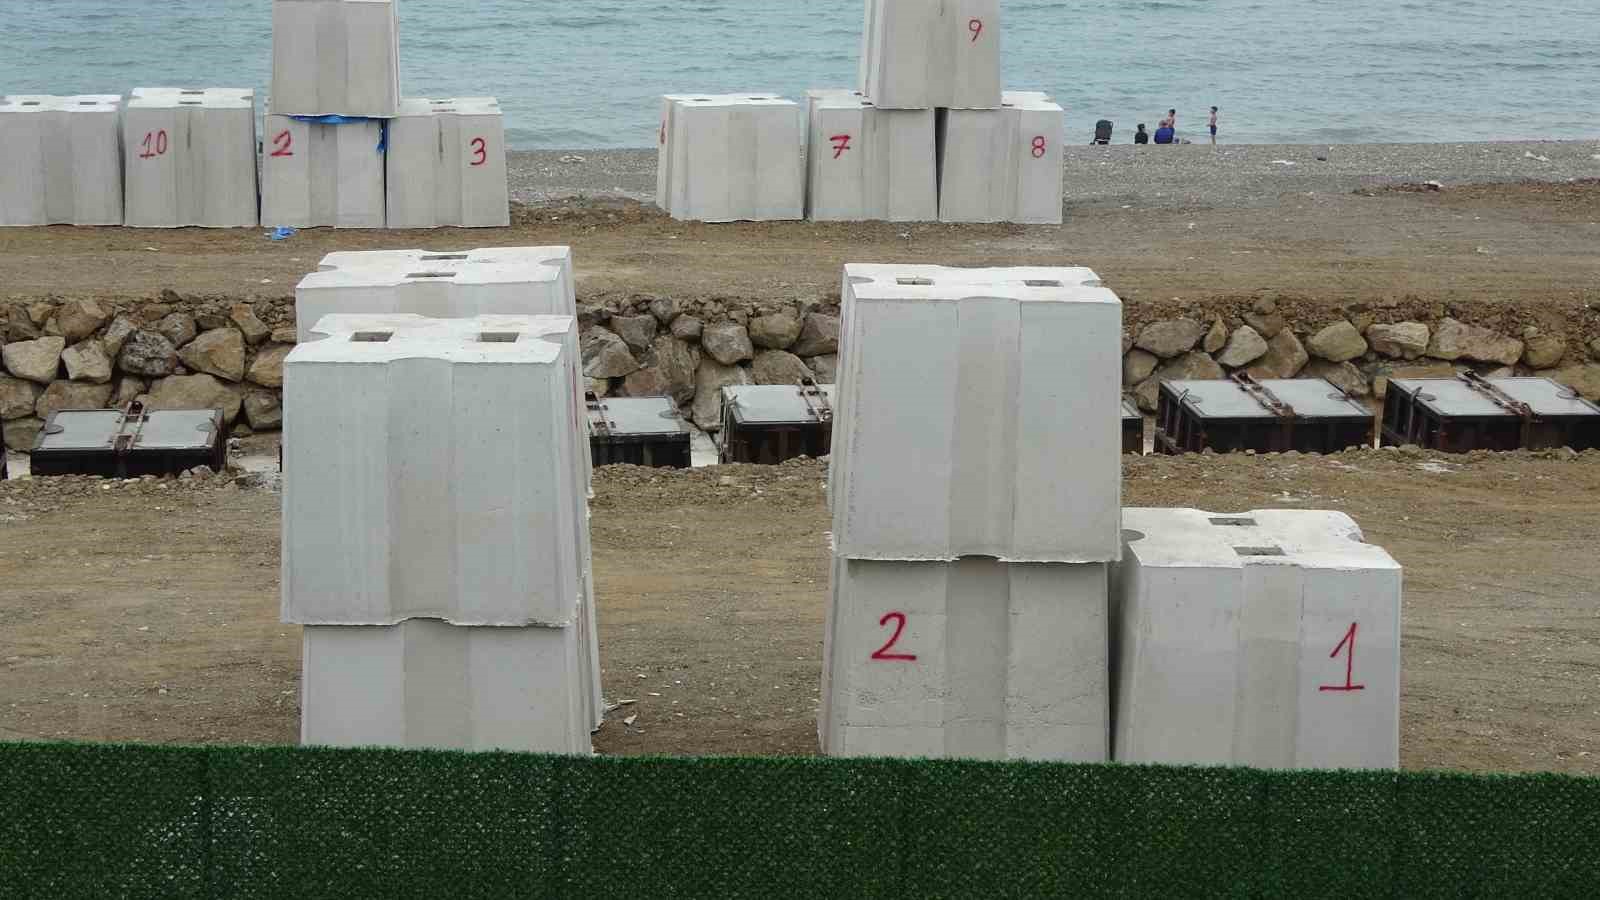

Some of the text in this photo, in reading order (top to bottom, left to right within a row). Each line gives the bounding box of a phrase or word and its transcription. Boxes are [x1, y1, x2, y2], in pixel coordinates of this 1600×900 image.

[969, 19, 982, 42] 9
[139, 130, 168, 159] 10
[270, 130, 293, 157] 2
[470, 137, 486, 165] 3
[829, 134, 851, 159] 7
[1031, 135, 1045, 158] 8
[871, 612, 917, 661] 2
[1318, 622, 1365, 692] 1
